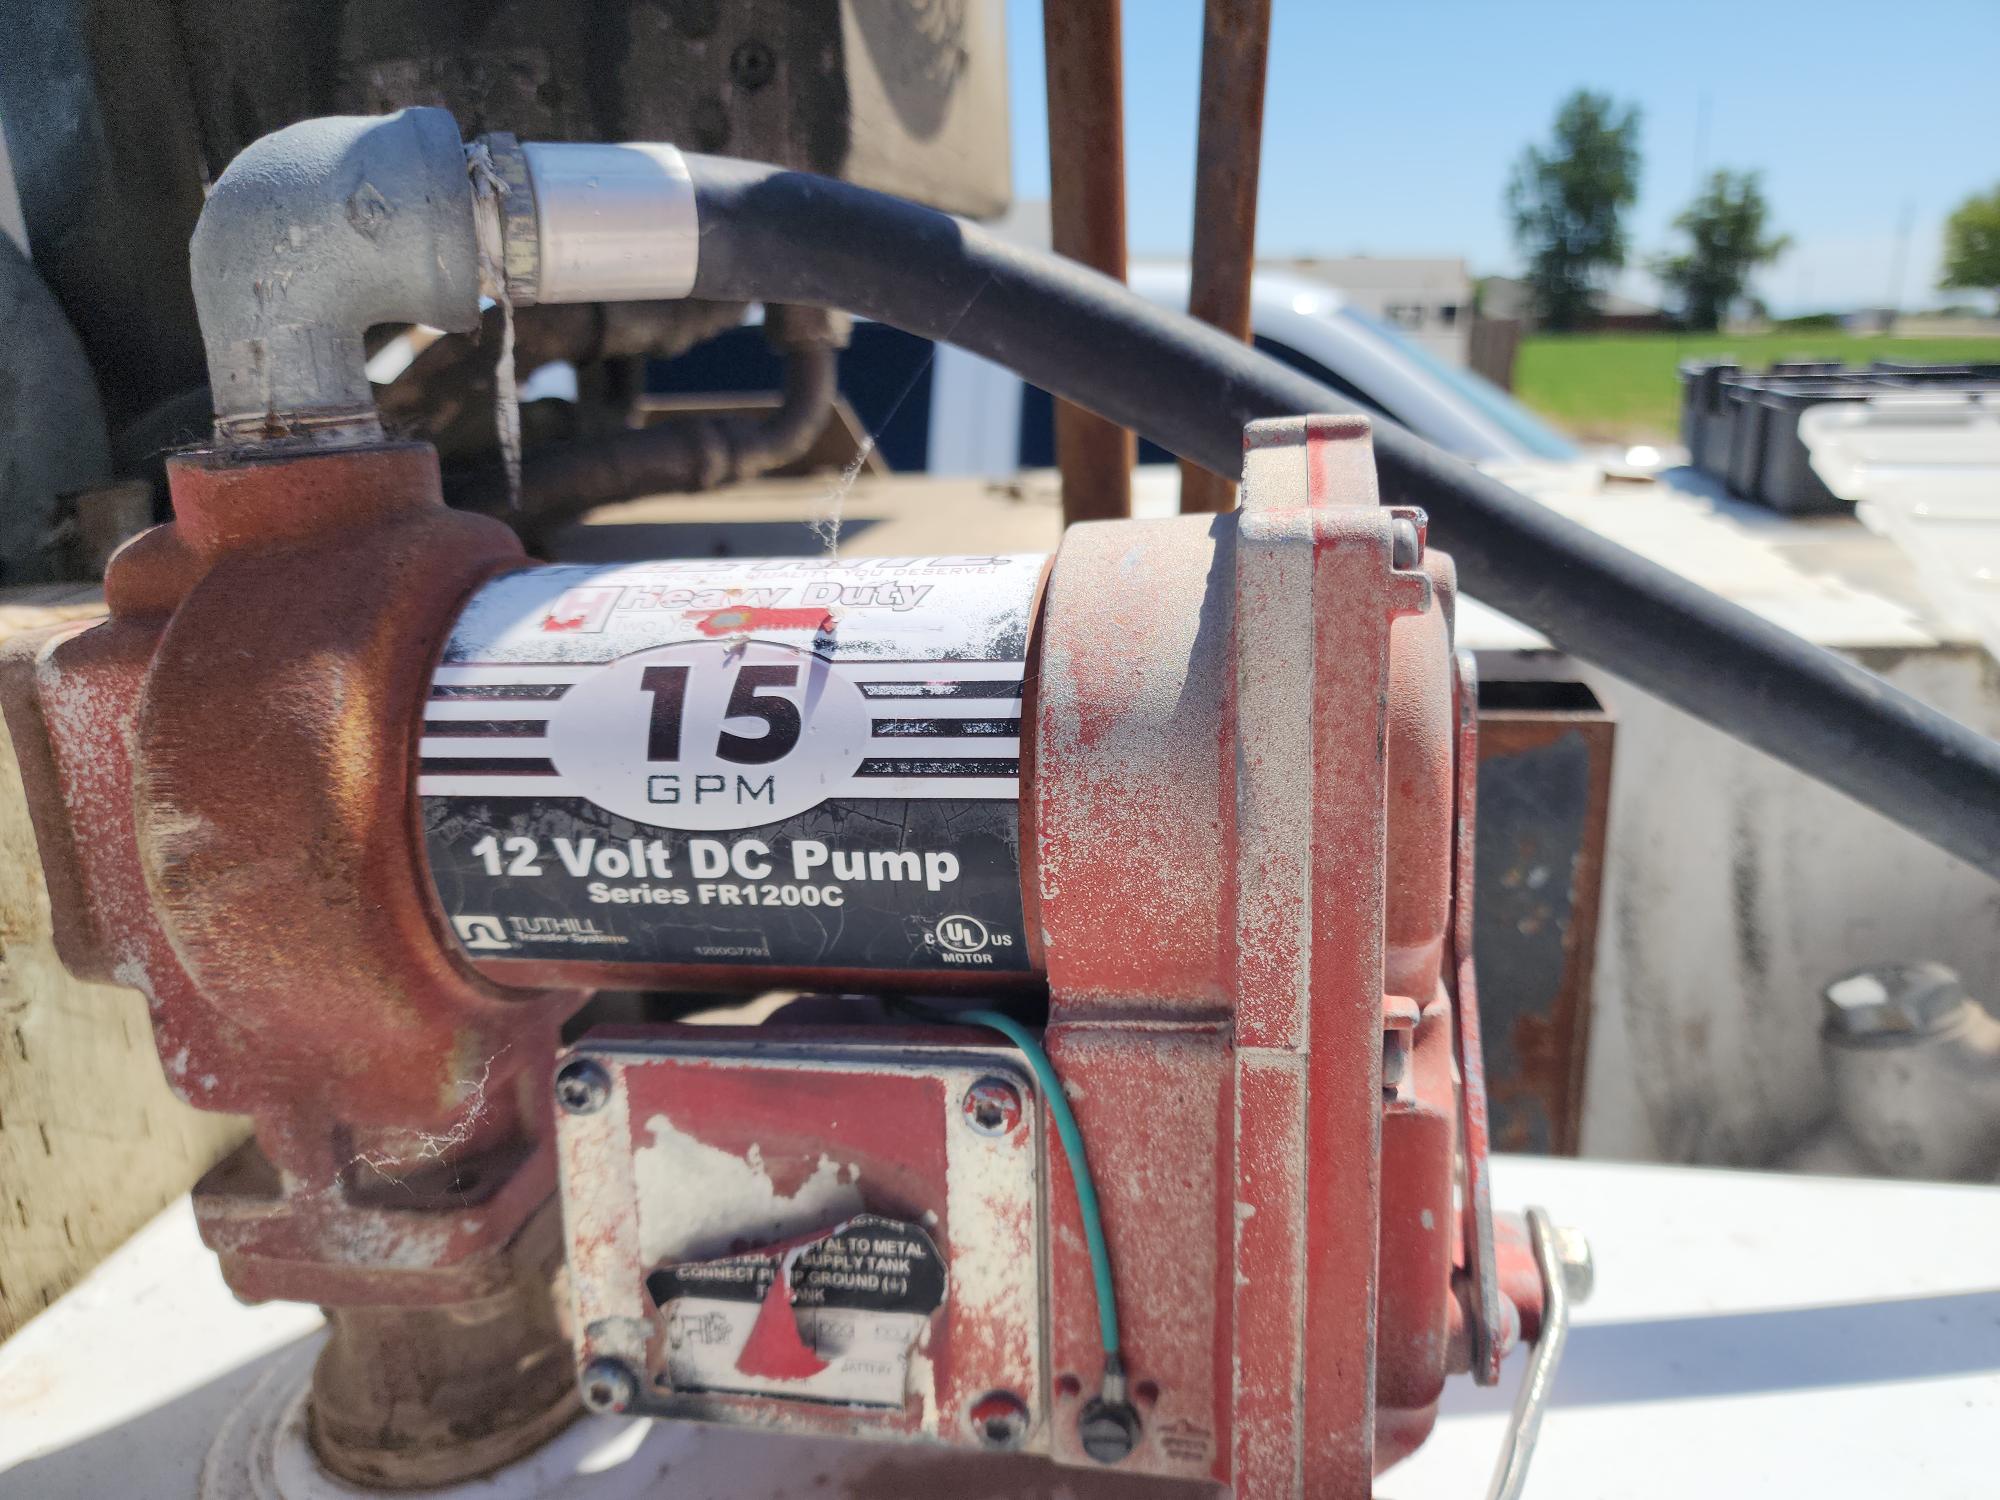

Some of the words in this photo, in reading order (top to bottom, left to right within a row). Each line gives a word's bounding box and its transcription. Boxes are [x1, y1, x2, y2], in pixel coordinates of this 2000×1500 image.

[844, 568, 881, 577] YOU
[894, 566, 998, 576] DESERVE!
[617, 584, 792, 610] Heavy
[800, 580, 934, 613] Duty
[640, 665, 803, 765] 15
[647, 774, 776, 806] GPM
[472, 836, 542, 878] 12
[550, 838, 671, 880] Volt
[689, 840, 771, 880] DC
[793, 842, 960, 892] Pump
[589, 882, 690, 906] Series
[699, 884, 845, 908] FR1200C
[506, 916, 604, 933] TUTHILL
[945, 922, 978, 947] UL
[990, 934, 1013, 946] US
[514, 931, 568, 942] Transfer
[570, 933, 630, 945] Systems
[942, 953, 993, 964] MOTOR
[848, 1239, 870, 1254] TO
[873, 1241, 926, 1258] METAL
[802, 1253, 863, 1271] SUPPLY
[866, 1257, 910, 1273] TANK
[675, 1266, 755, 1282] CONNECT
[809, 1270, 879, 1291] GROUND
